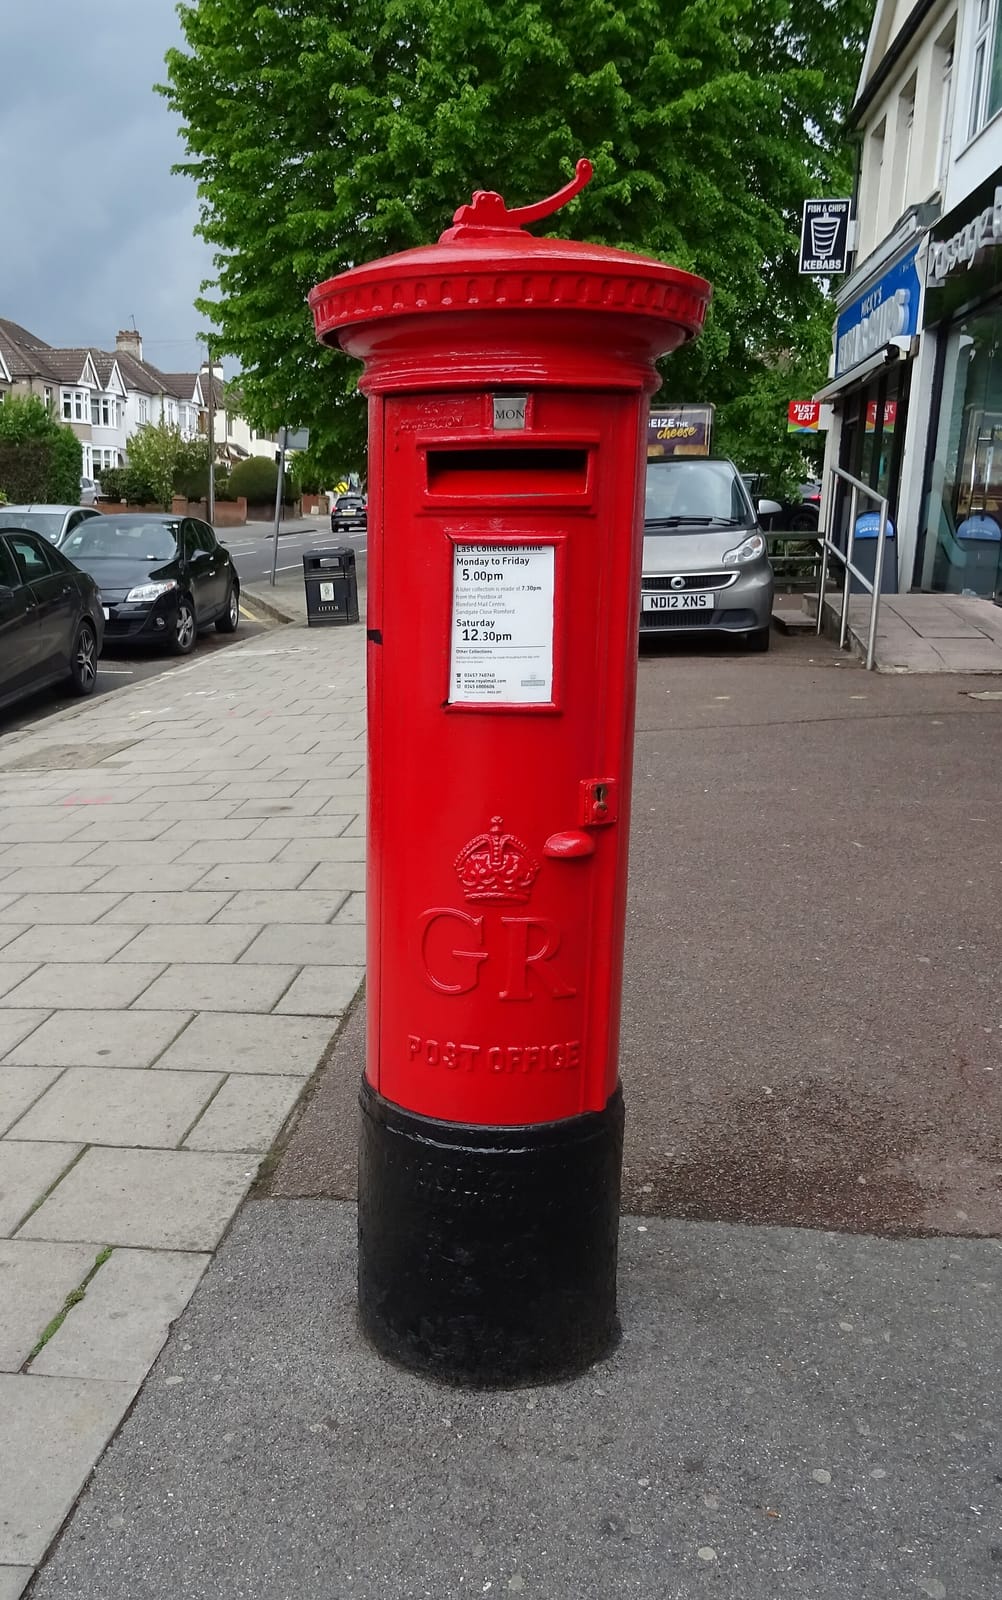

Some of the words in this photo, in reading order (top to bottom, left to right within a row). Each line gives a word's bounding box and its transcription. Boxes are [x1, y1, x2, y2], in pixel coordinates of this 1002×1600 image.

[808, 204, 821, 213] FISH
[828, 204, 846, 212] CHIPS
[804, 259, 841, 270] KEBABS
[794, 404, 815, 413] JUST
[496, 410, 524, 419] MON
[649, 419, 675, 428] EIZE
[656, 427, 697, 439] cheese
[456, 558, 489, 567] Monday
[502, 557, 530, 566] Friday
[462, 569, 503, 582] 5.00pm
[651, 597, 678, 608] ND12
[682, 595, 706, 607] XNS
[456, 619, 495, 628] Saturday
[462, 629, 512, 642] 12.30pm
[408, 1034, 480, 1072] POST
[489, 1041, 580, 1073] OFFICE
